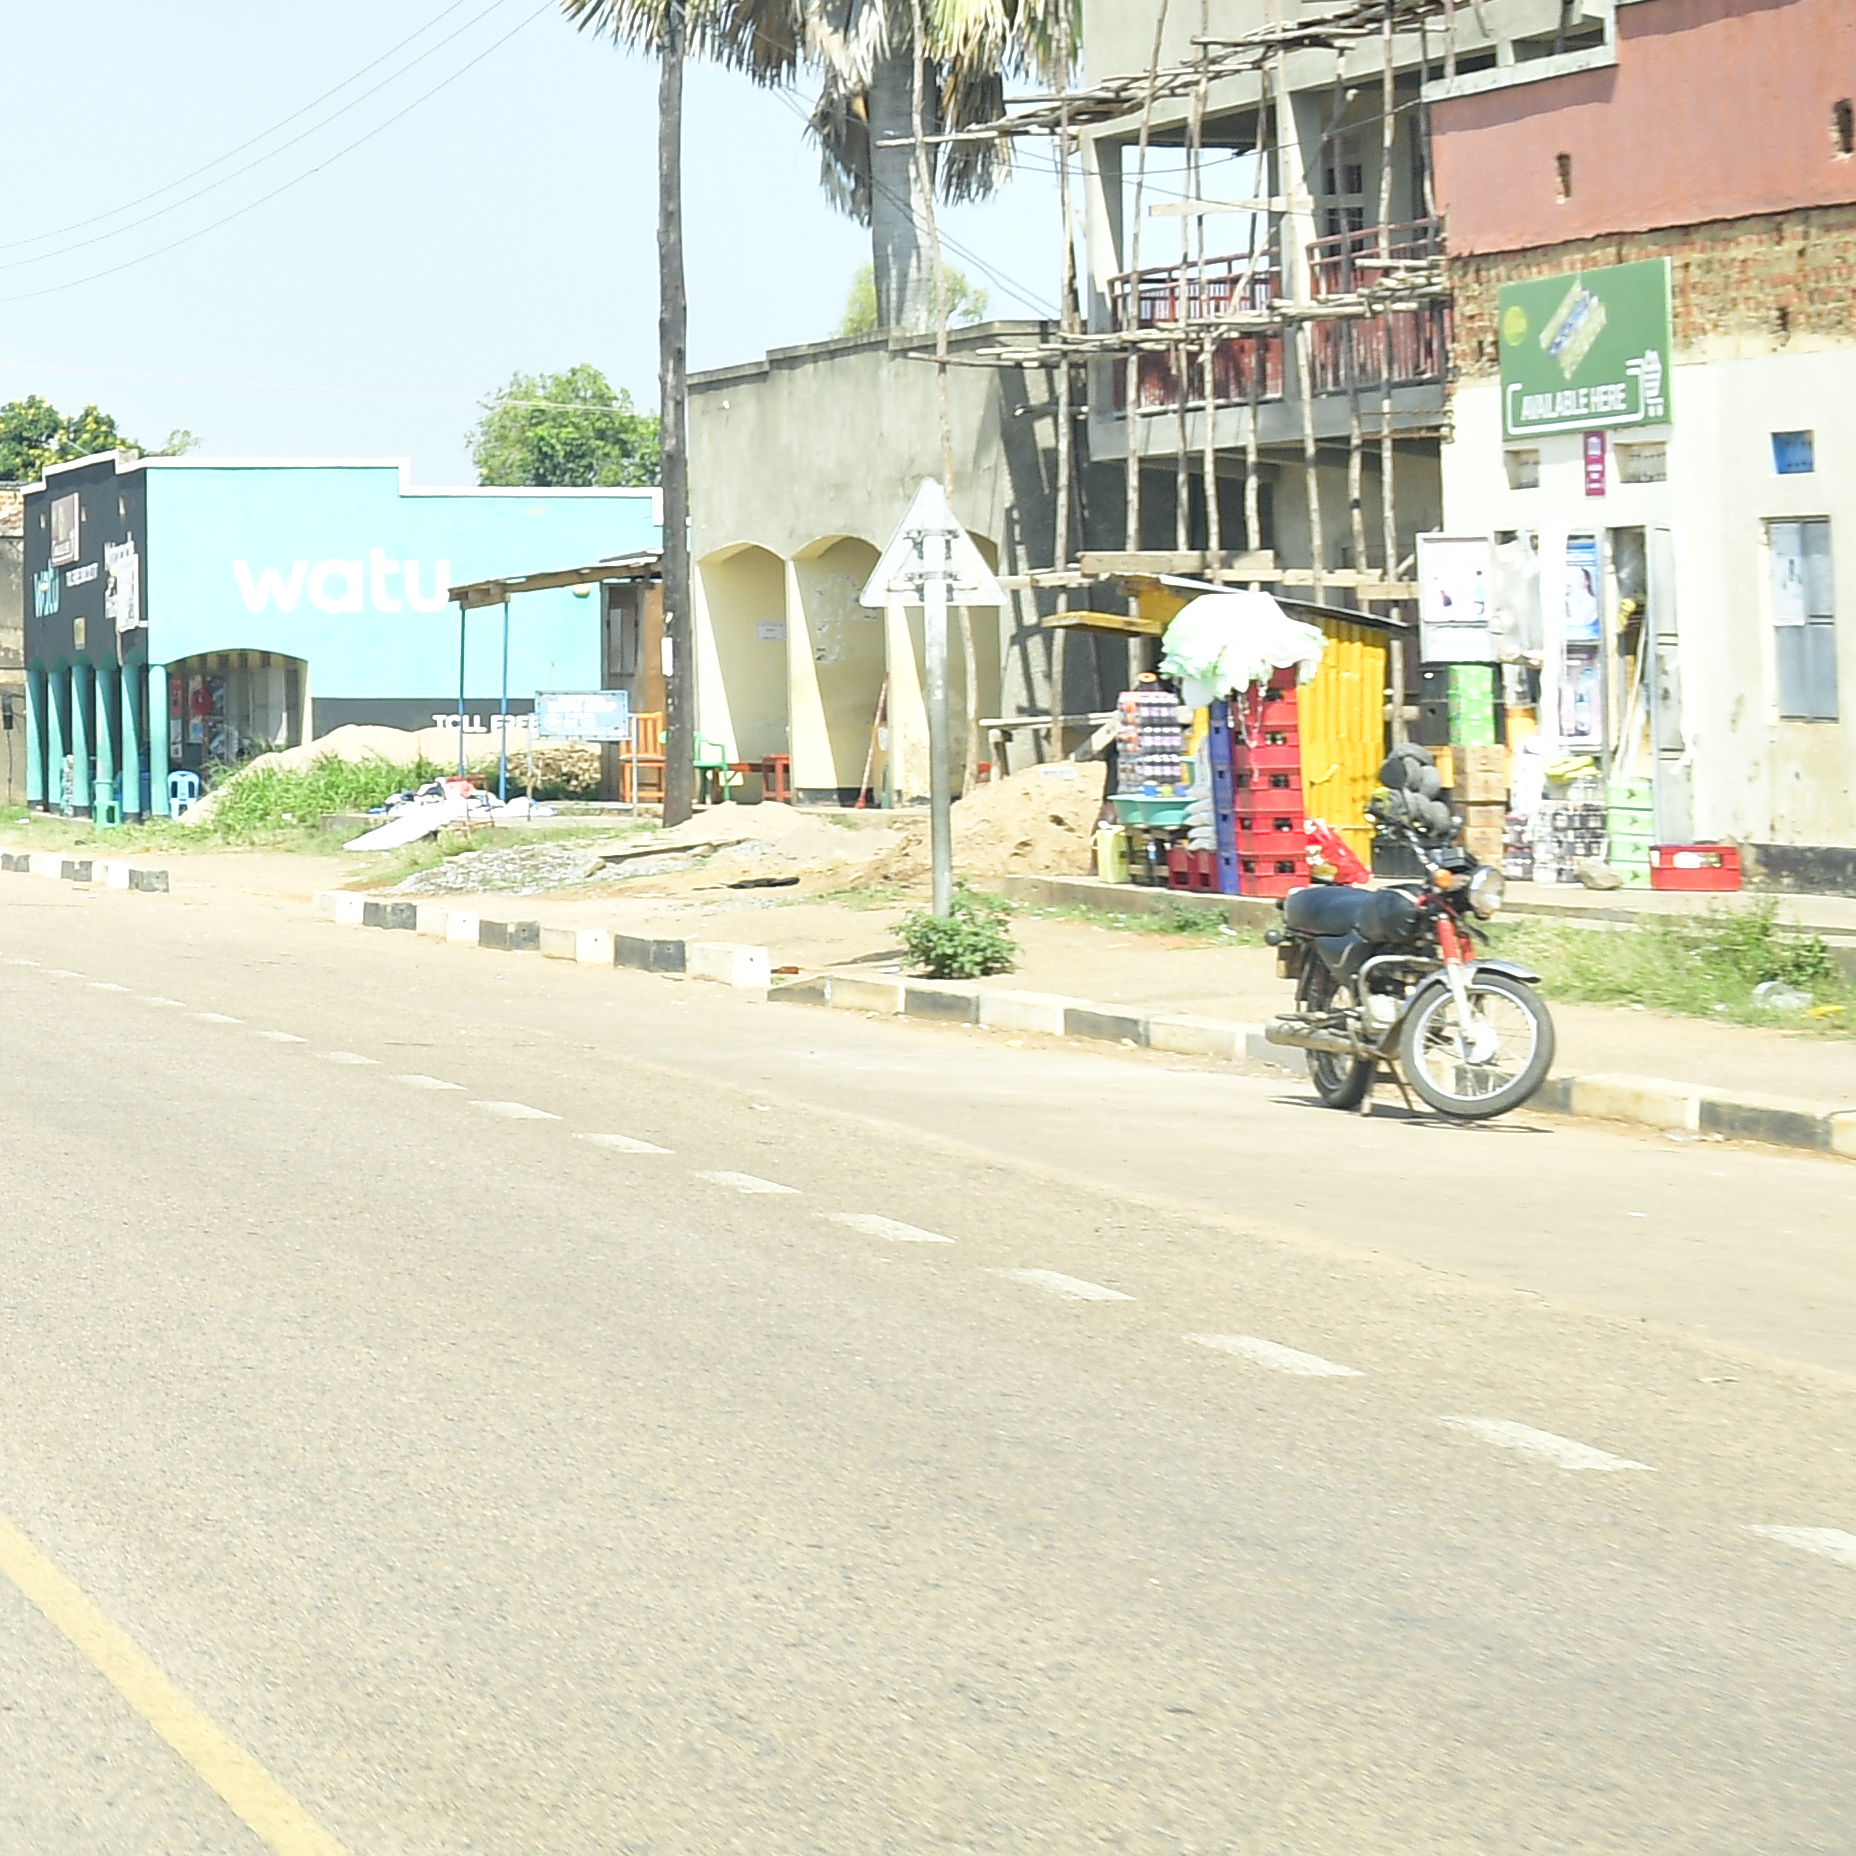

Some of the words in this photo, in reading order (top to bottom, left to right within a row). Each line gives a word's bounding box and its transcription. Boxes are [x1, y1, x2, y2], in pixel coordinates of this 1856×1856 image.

[1520, 388, 1589, 422] AVAILABLE
[1590, 382, 1628, 413] HERE
[231, 548, 450, 614] watu
[432, 714, 488, 734] TOLL
